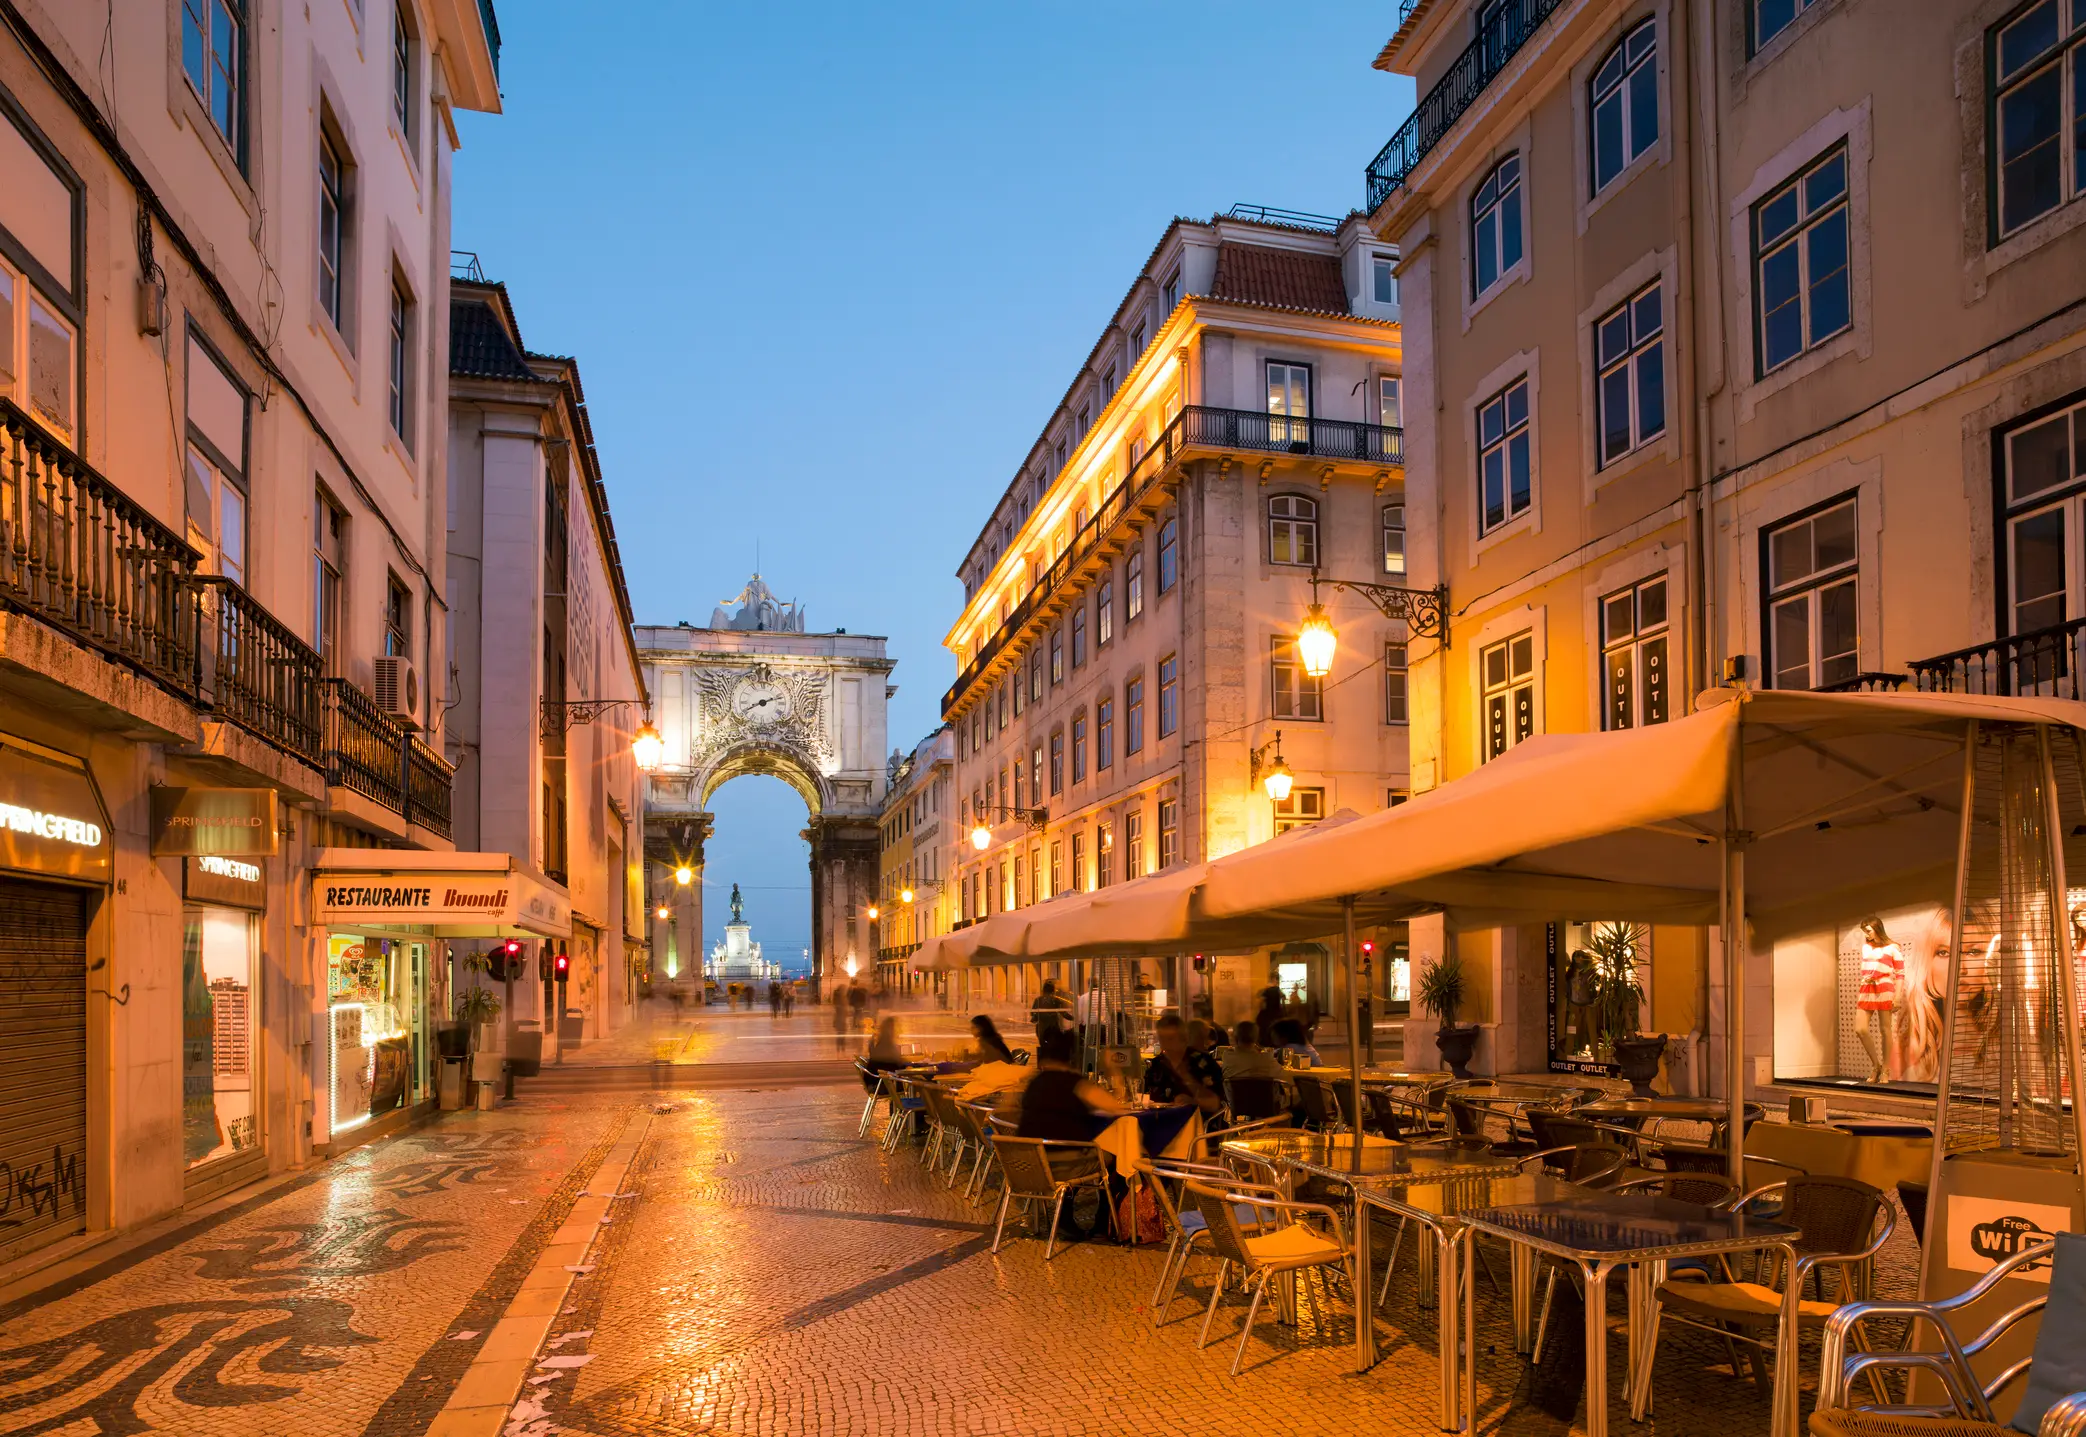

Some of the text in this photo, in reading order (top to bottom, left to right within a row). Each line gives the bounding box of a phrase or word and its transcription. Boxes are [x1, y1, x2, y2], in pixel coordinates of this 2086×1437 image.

[165, 816, 262, 827] SPRINGFIELD
[199, 856, 260, 882] SPRINGFIELD
[326, 887, 431, 907] RESTAURANTE
[443, 889, 508, 907] Buondi
[1551, 1061, 1608, 1073] OUTLET OUTLET
[2003, 1219, 2031, 1231] Free
